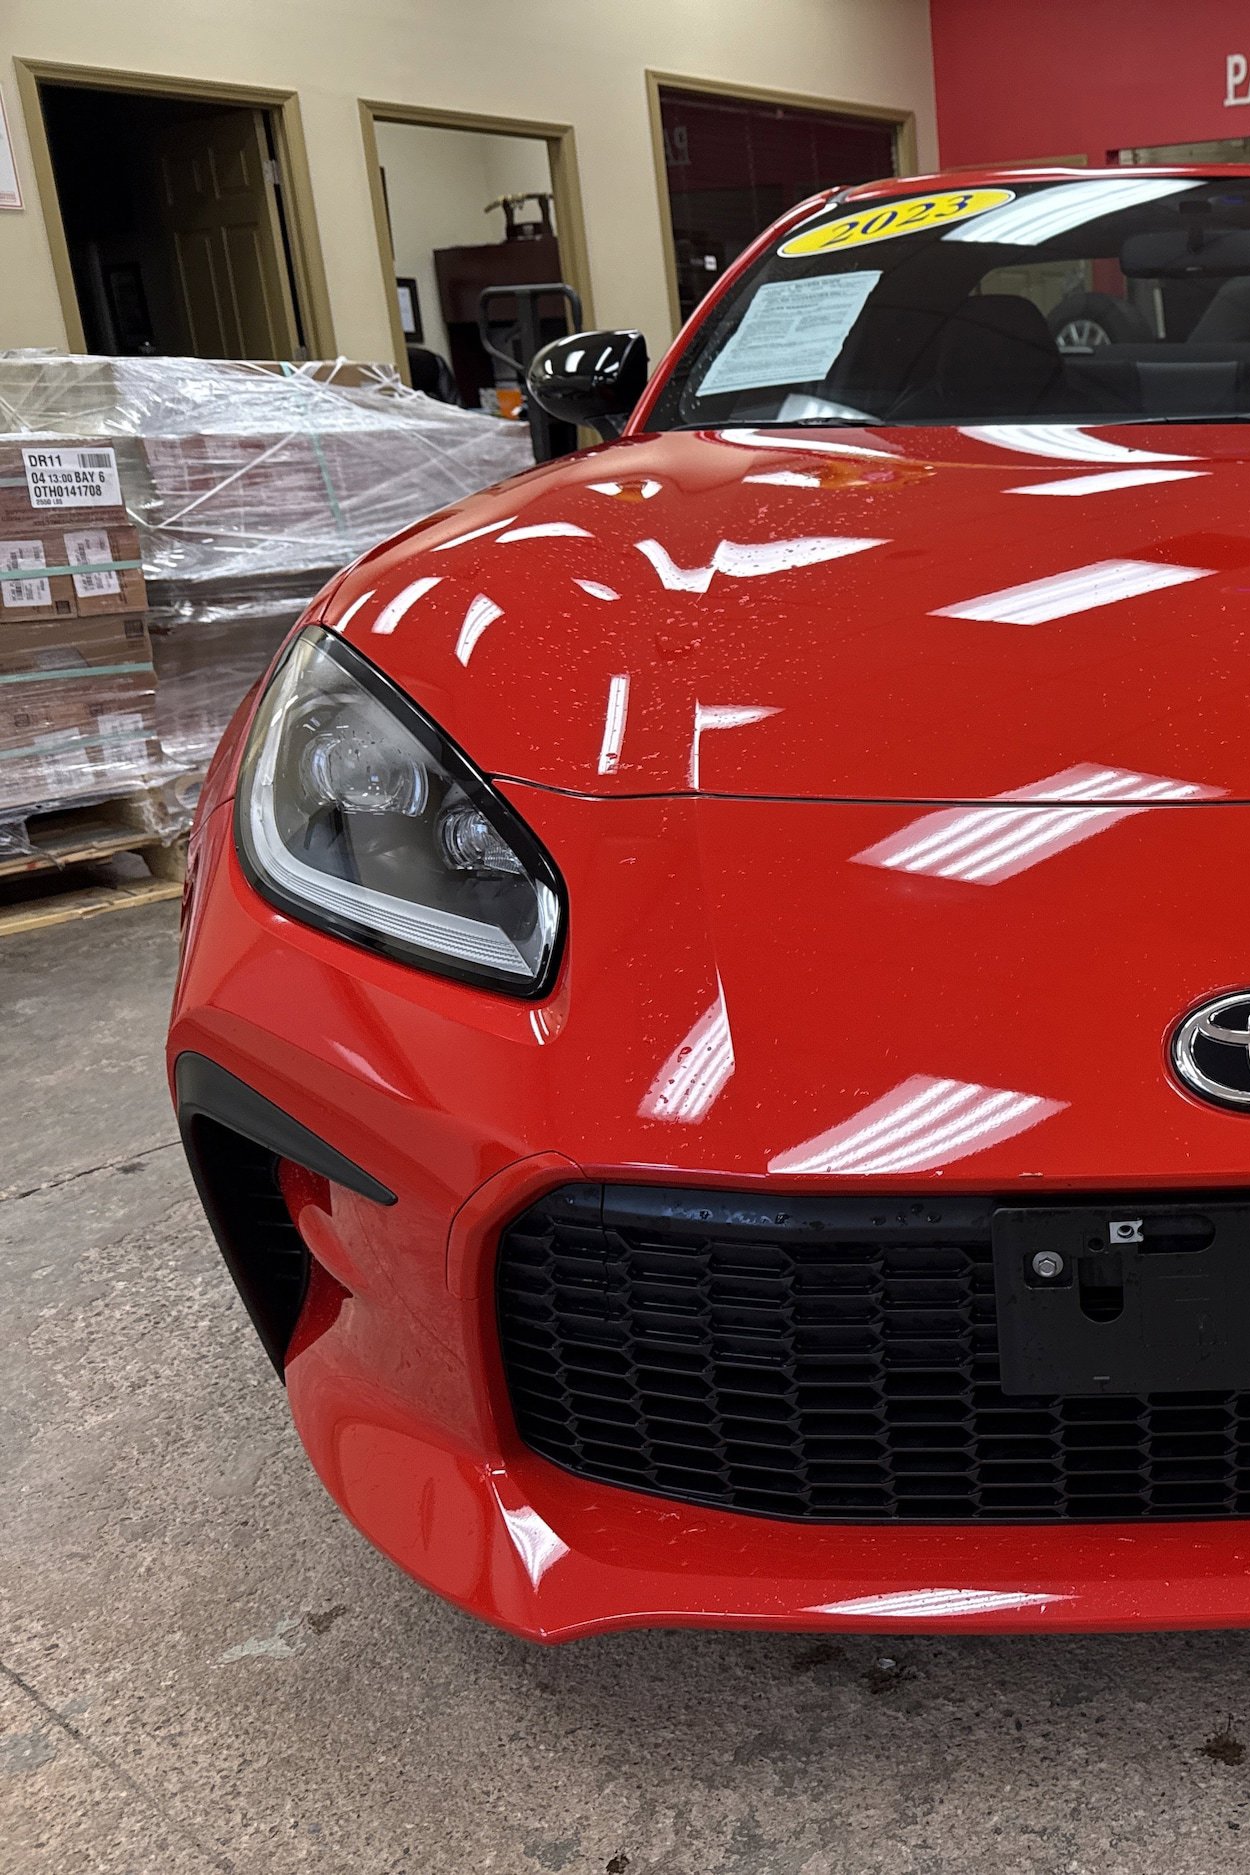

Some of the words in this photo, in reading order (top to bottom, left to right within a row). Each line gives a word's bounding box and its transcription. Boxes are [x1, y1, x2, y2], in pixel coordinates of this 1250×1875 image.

[819, 194, 974, 248] 2023
[28, 454, 62, 467] DR11
[31, 472, 46, 484] 04
[48, 473, 73, 484] 13:00
[75, 471, 95, 484] BAY
[98, 471, 106, 483] 6
